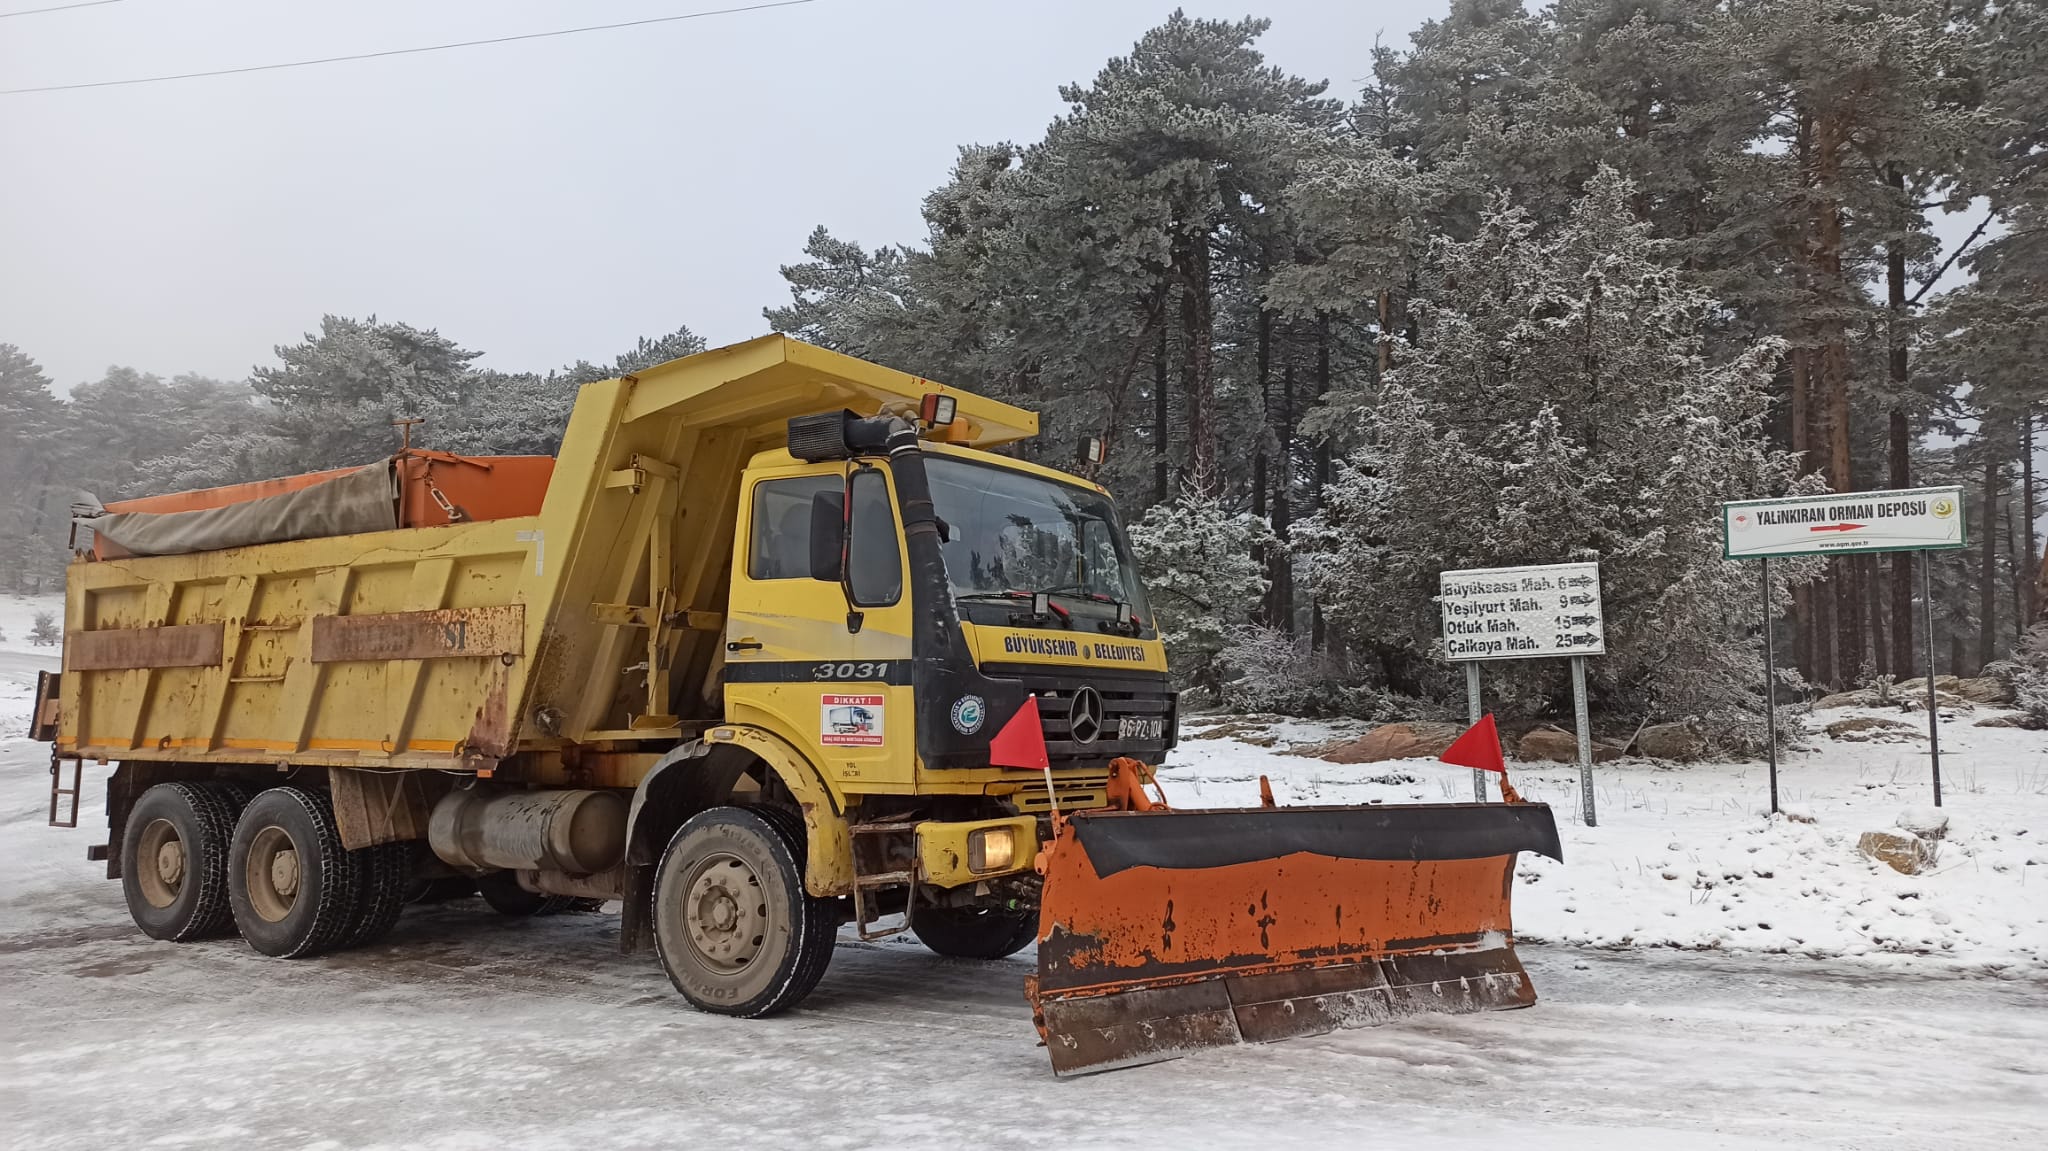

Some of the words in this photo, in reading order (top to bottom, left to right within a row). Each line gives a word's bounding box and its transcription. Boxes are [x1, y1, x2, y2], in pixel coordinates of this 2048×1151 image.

[1829, 503, 1874, 521] ORMAN
[1877, 500, 1927, 518] DEPOSU
[1521, 577, 1555, 592] Mah.
[1558, 576, 1567, 590] 6
[1444, 600, 1506, 618] Yeşilyurt
[1509, 597, 1543, 612] Mah.
[1559, 594, 1569, 608] 9
[1447, 620, 1483, 635] Otluk
[1487, 618, 1520, 633] Mah.
[1554, 616, 1572, 630] 15
[1004, 633, 1078, 658] BÜYÜKŞEHİR
[1094, 643, 1146, 662] BELEDİYESİ
[1448, 639, 1503, 657] Çalkaya
[1506, 636, 1540, 651] Mah.
[1555, 634, 1573, 648] 25
[818, 662, 889, 679] 3031
